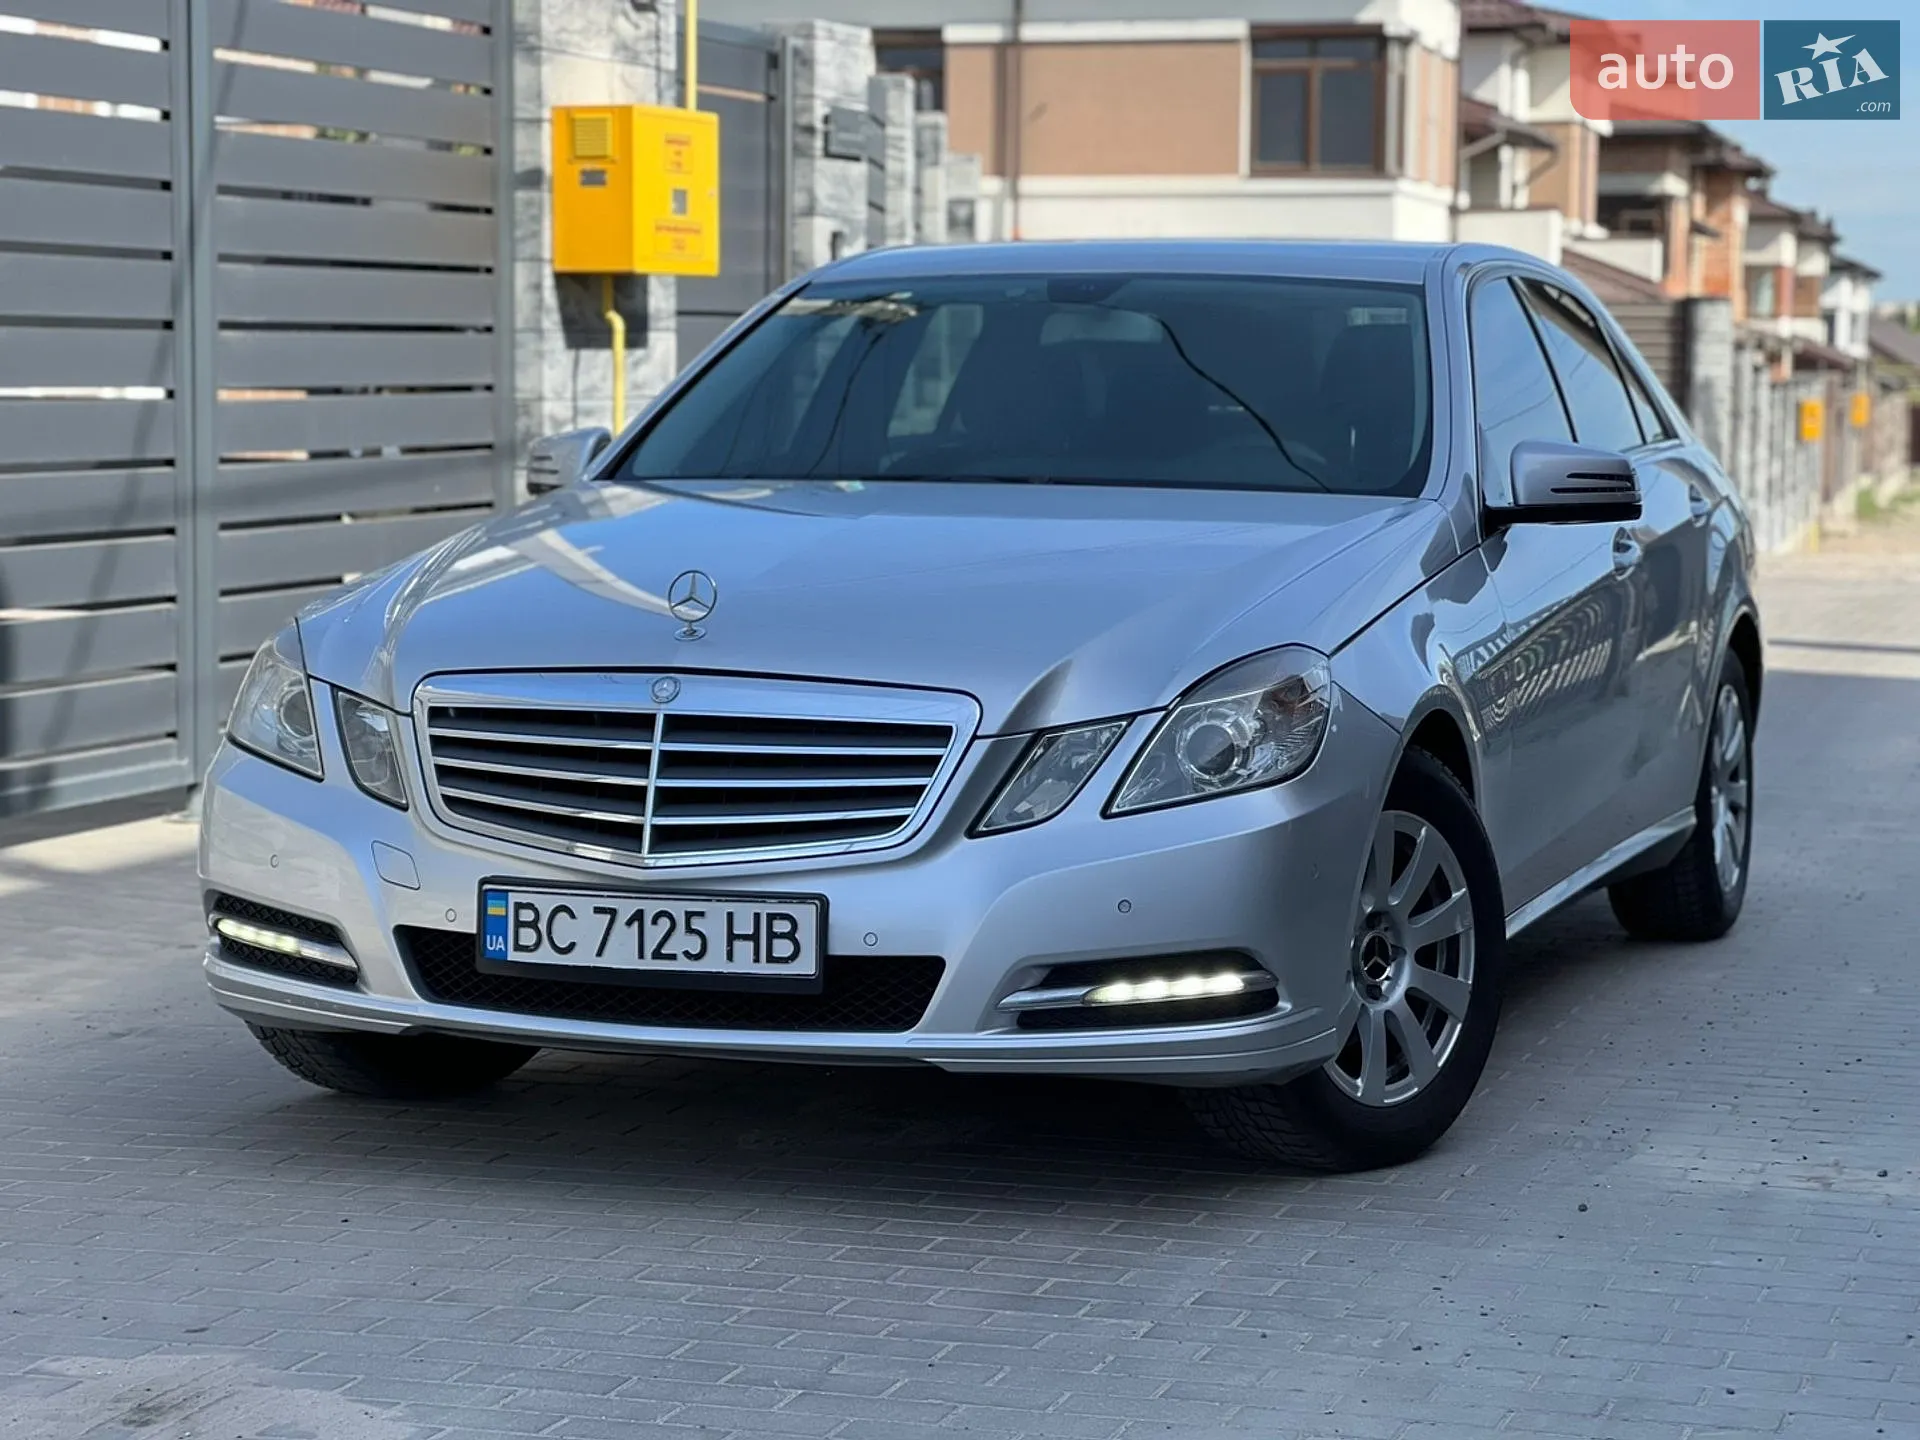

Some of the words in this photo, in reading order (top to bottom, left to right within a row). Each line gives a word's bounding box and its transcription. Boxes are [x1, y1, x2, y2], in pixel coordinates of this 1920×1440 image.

[486, 935, 506, 952] UA
[512, 901, 577, 955] BC
[592, 906, 708, 961] 7125
[725, 911, 801, 964] HB
